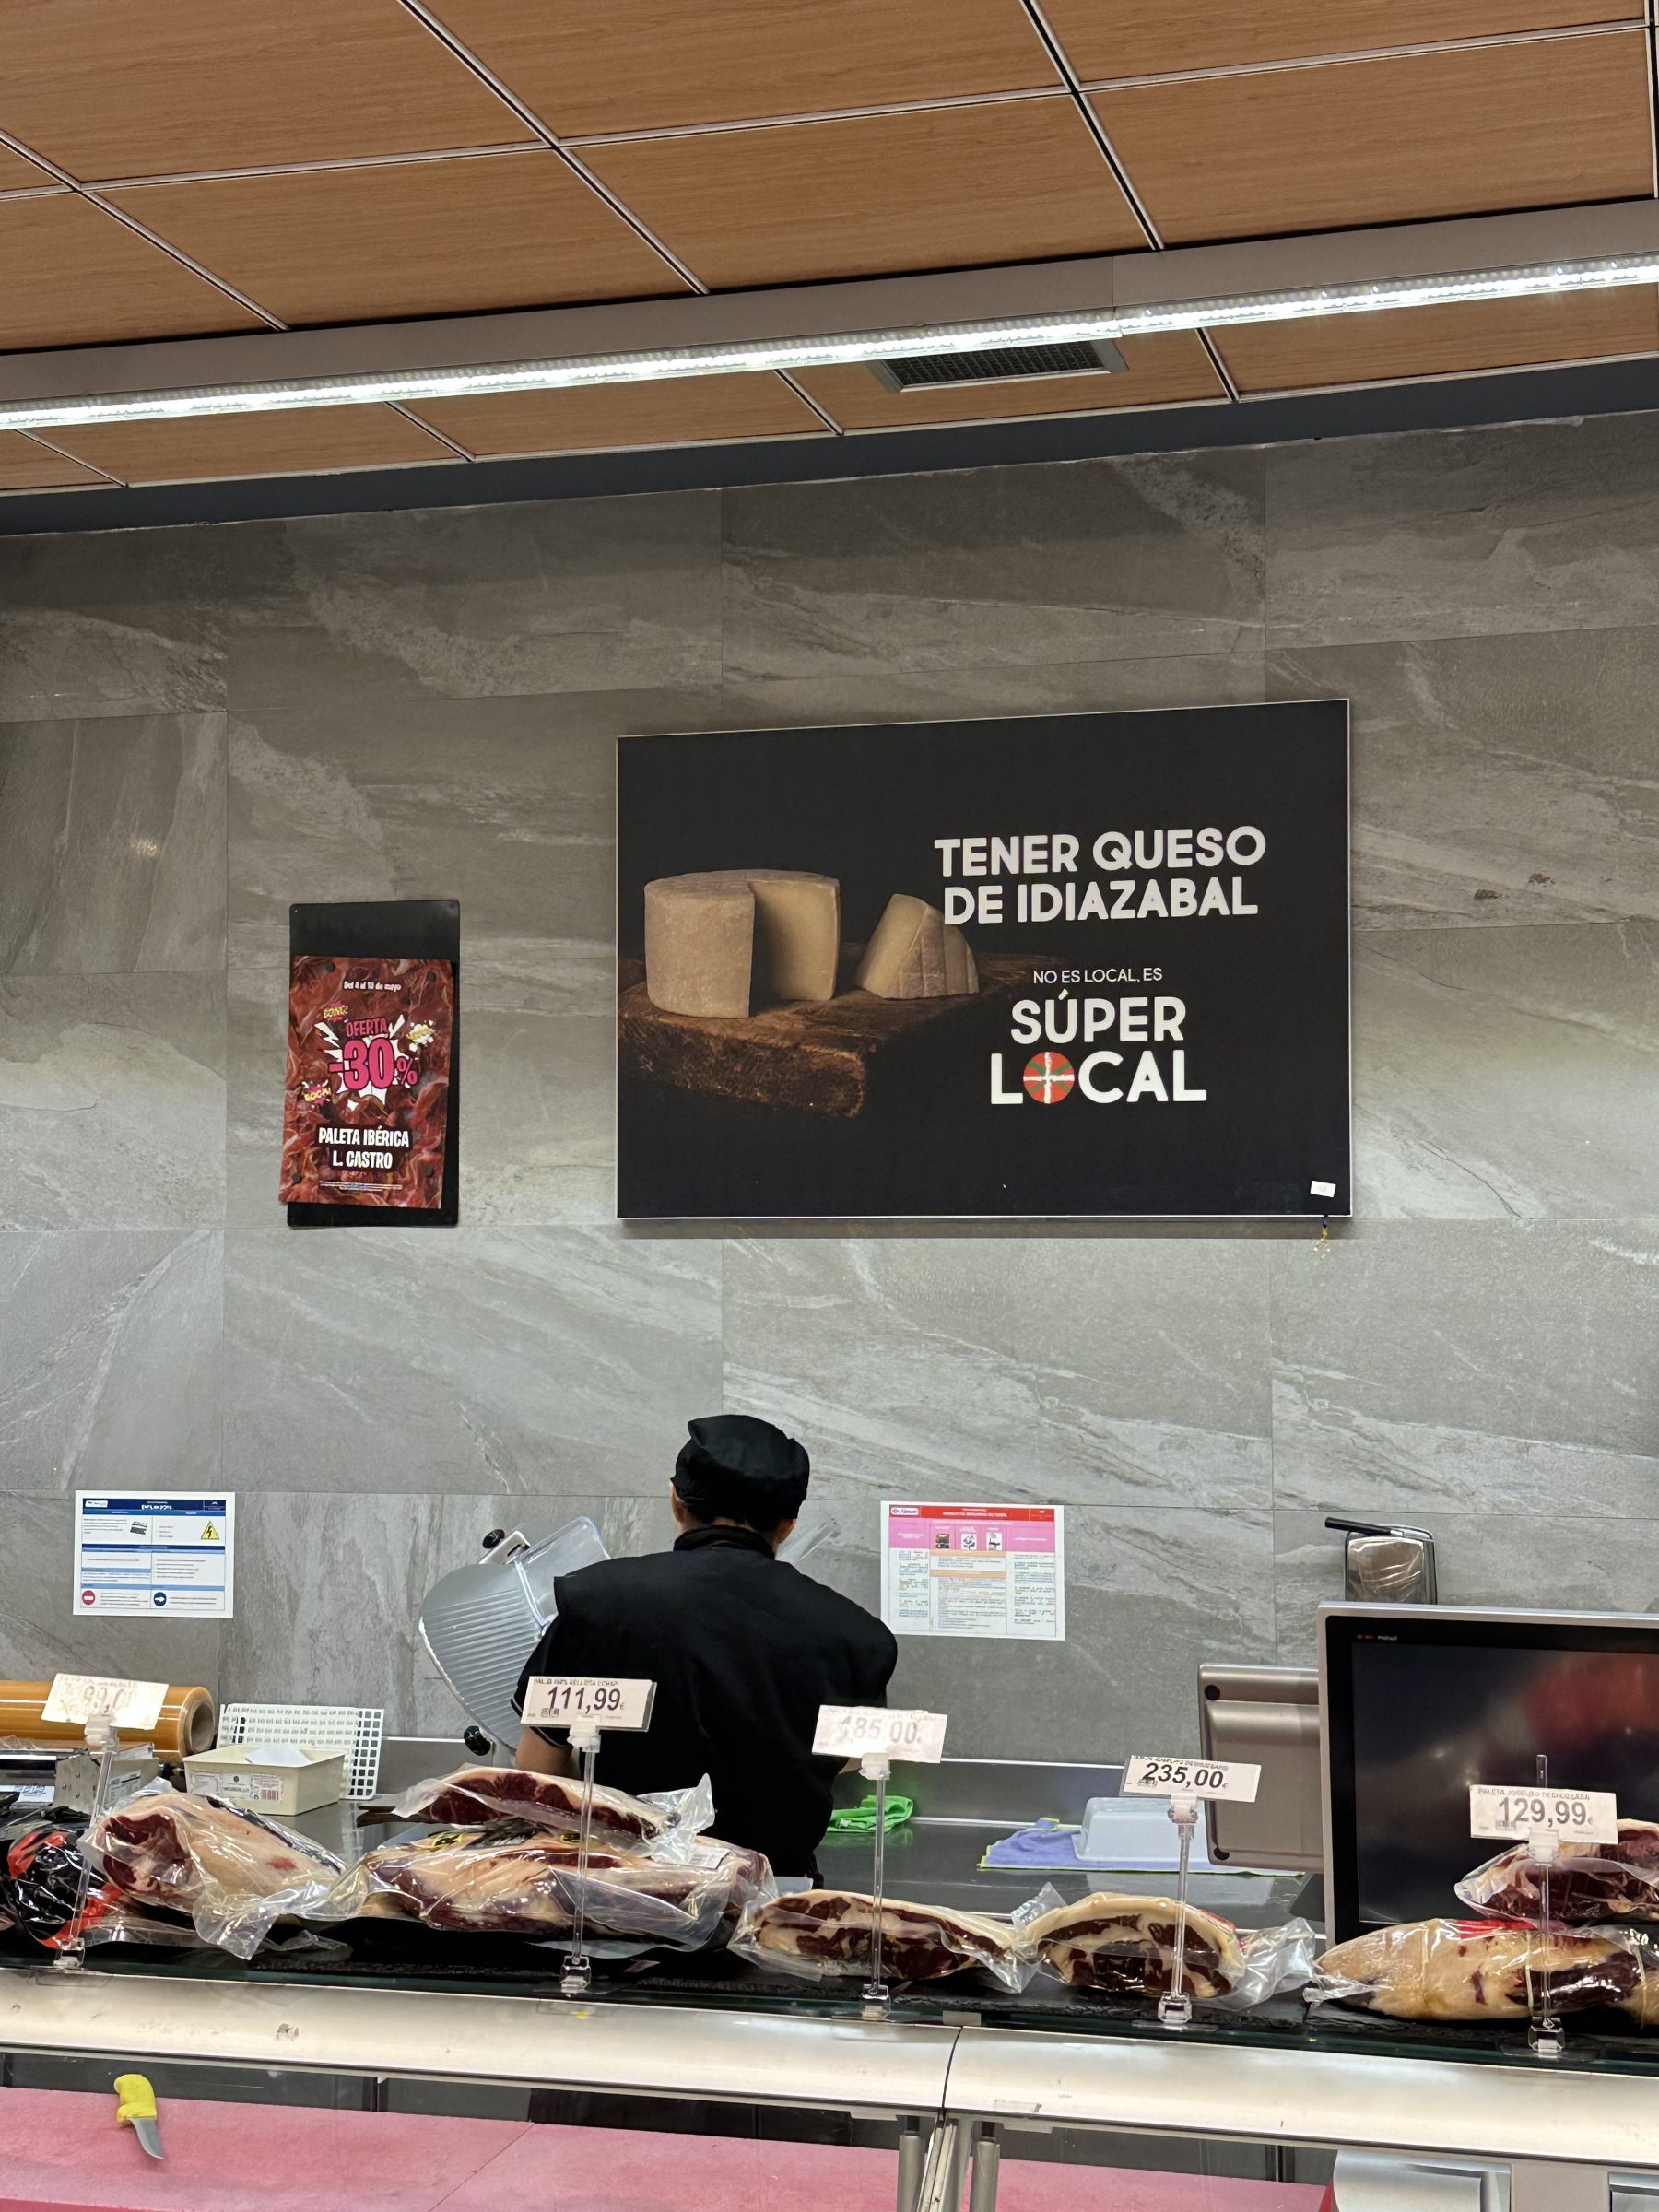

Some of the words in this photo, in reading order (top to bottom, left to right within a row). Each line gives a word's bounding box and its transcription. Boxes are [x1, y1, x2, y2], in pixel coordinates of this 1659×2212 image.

[934, 835, 1079, 877] TENER
[1092, 825, 1266, 871] QUESO
[944, 885, 1003, 925] DE
[1018, 876, 1259, 923] IDIAZABAL
[343, 980, 354, 990] Del
[359, 982, 367, 990] al
[375, 982, 383, 991] de
[384, 983, 402, 993] mayo
[1033, 971, 1058, 984] NO
[1061, 970, 1081, 983] ES
[1084, 968, 1140, 982] LOCAL,
[1143, 967, 1163, 982] ES
[1011, 988, 1186, 1044] SÚPER
[346, 1018, 388, 1038] OFERTA
[328, 1038, 418, 1090] -30%
[318, 1127, 361, 1146] PALETA
[363, 1125, 410, 1147] IBÉRICA
[332, 1150, 344, 1167] L.
[346, 1151, 394, 1170] CASTRO
